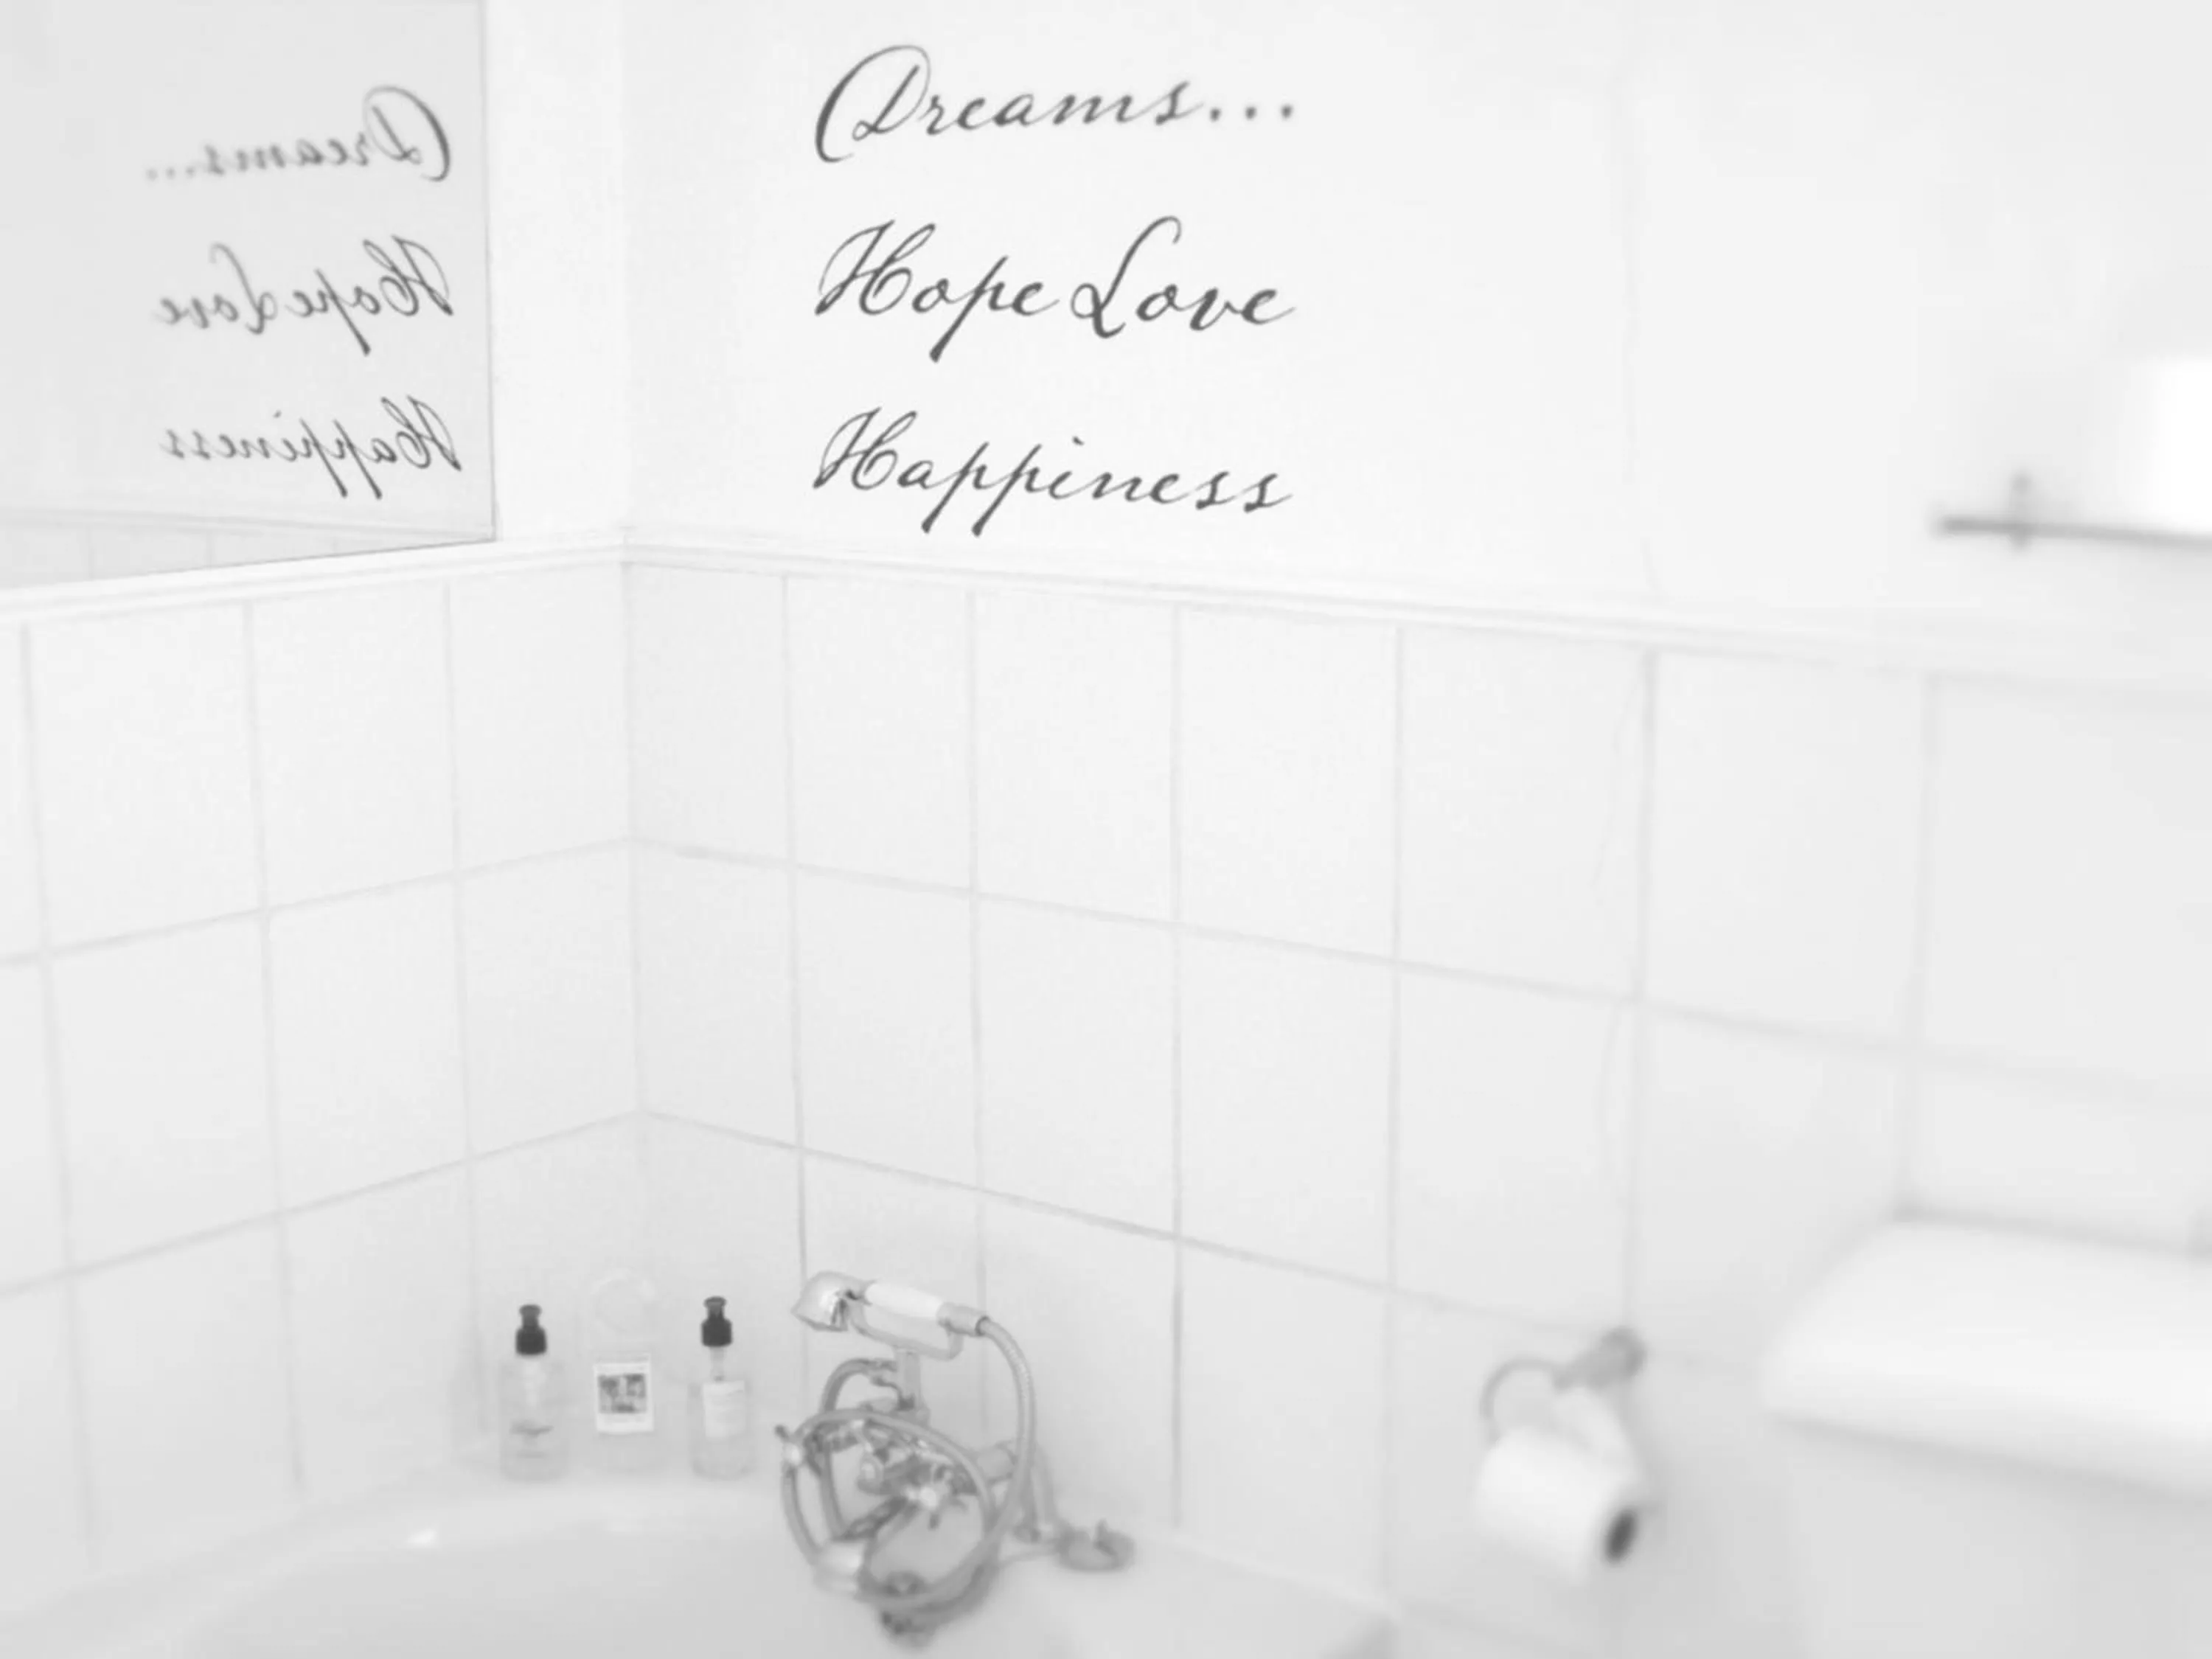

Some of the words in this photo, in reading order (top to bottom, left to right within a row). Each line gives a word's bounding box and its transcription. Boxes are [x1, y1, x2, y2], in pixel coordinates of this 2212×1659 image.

[813, 44, 1294, 164] Dreams...
[813, 219, 1060, 364] Hope
[1069, 215, 1297, 340] Love
[811, 406, 1294, 538] Happiness
